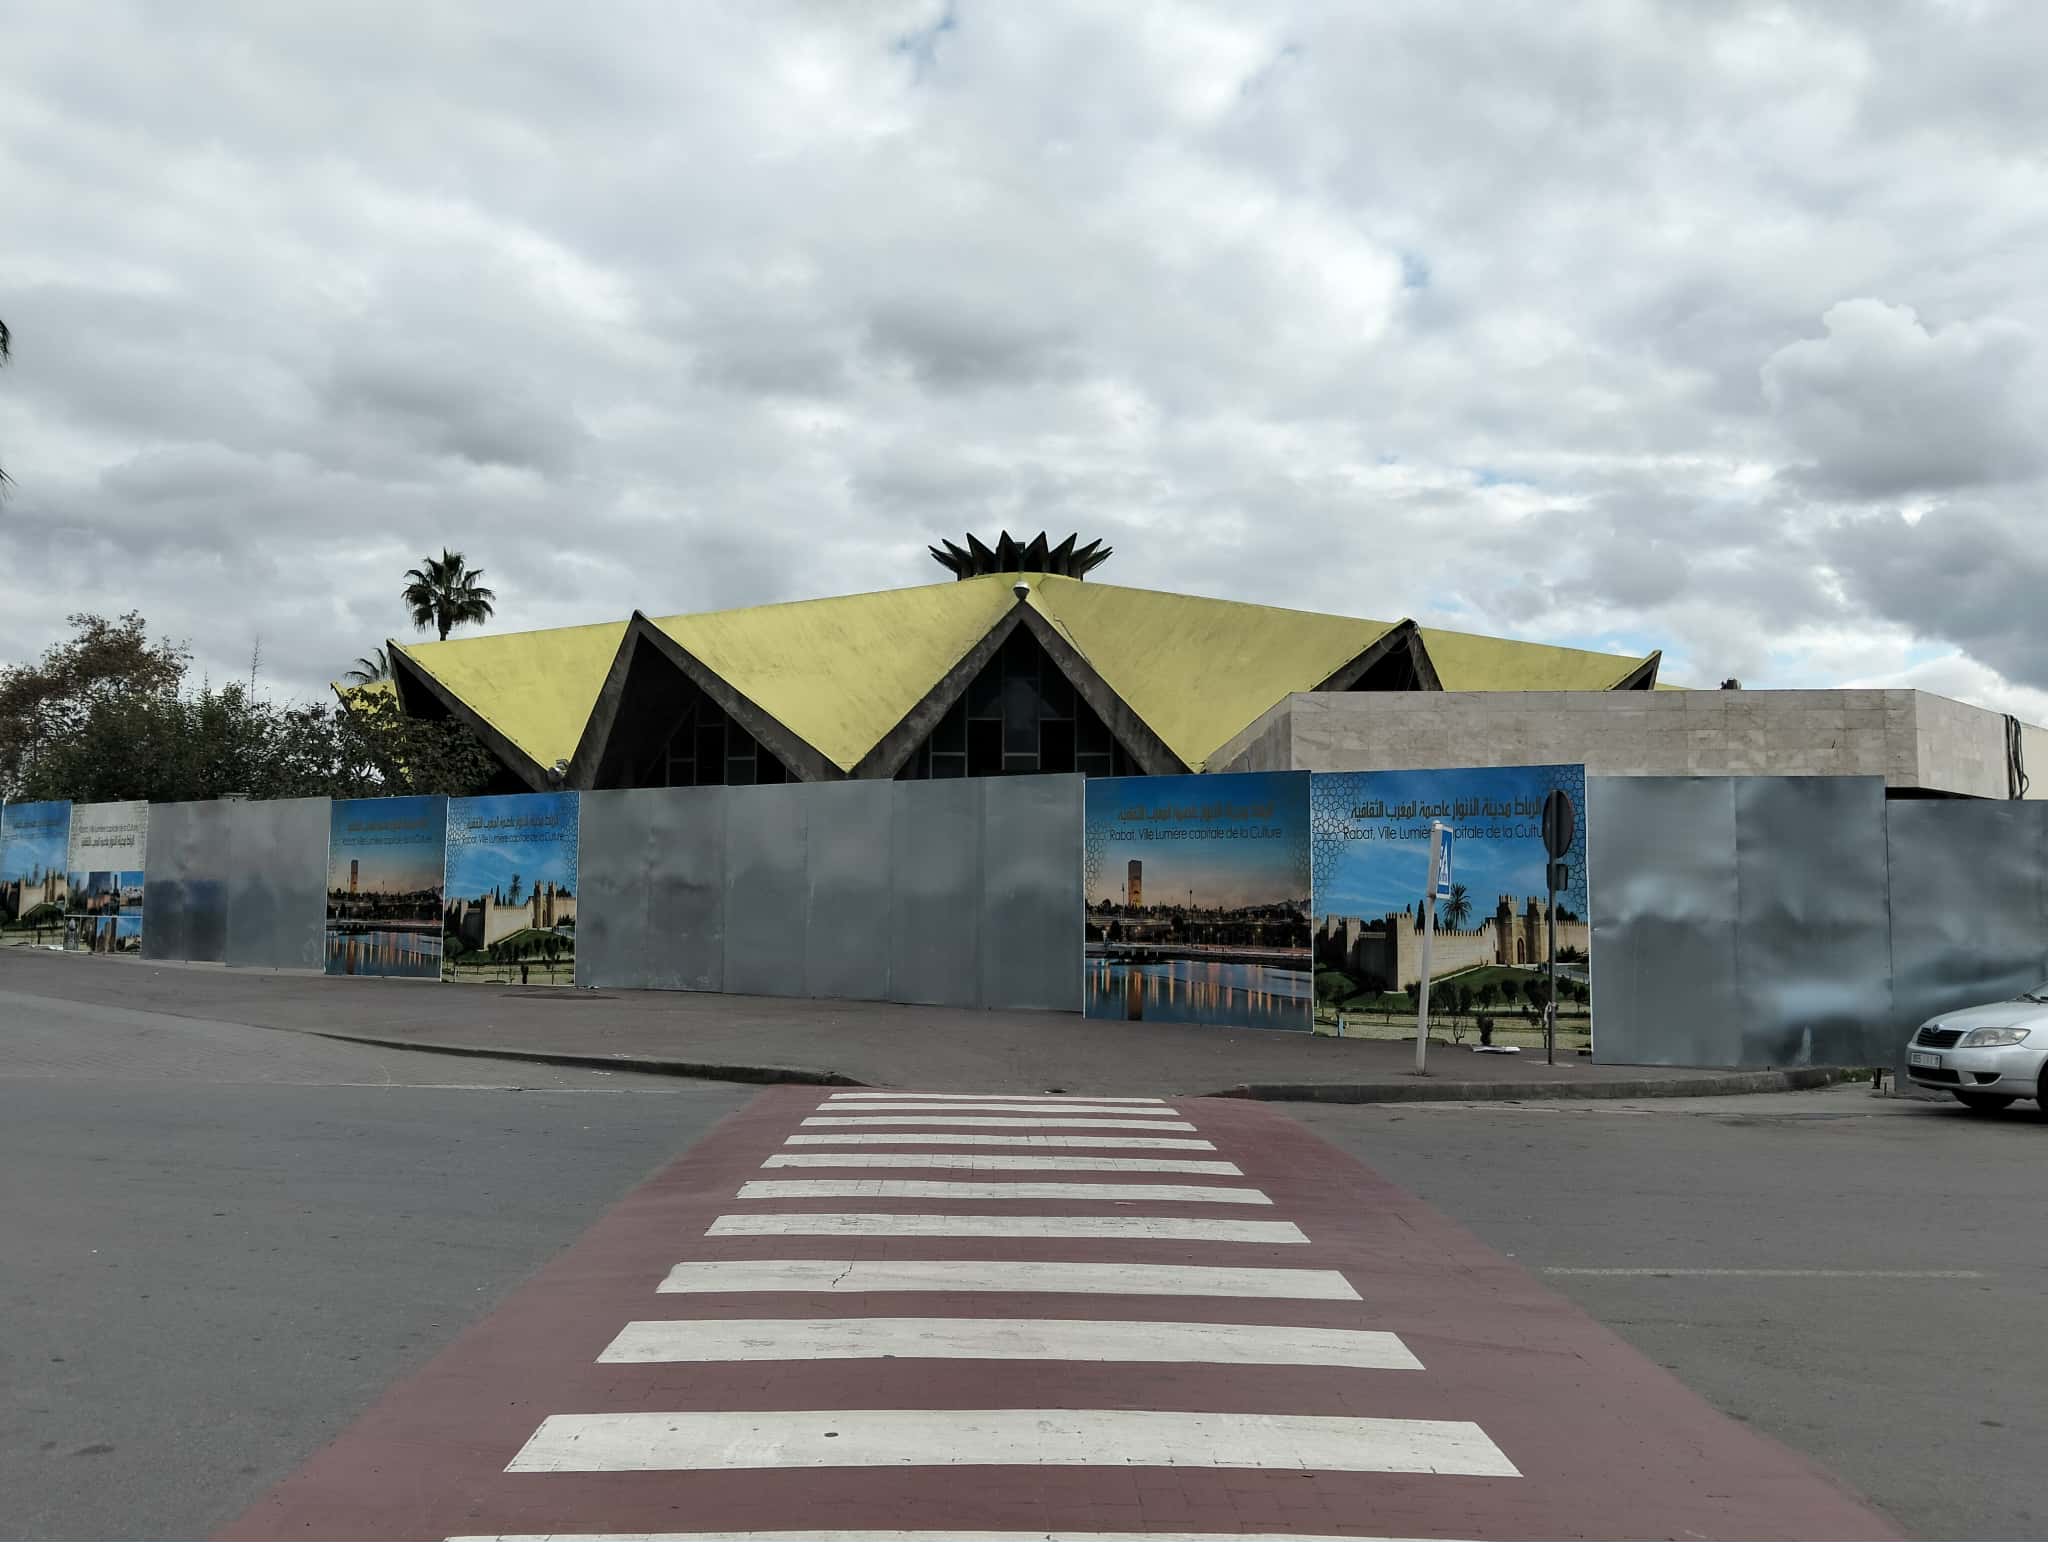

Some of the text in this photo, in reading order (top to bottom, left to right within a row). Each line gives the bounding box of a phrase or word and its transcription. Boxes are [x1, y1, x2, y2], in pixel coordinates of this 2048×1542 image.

[1351, 798, 1384, 822] الثقافية
[1385, 799, 1417, 822] المغرب
[1419, 799, 1451, 820] عاصمة
[1377, 825, 1397, 840] Ville
[1486, 824, 1501, 840] de
[1502, 824, 1513, 840] la
